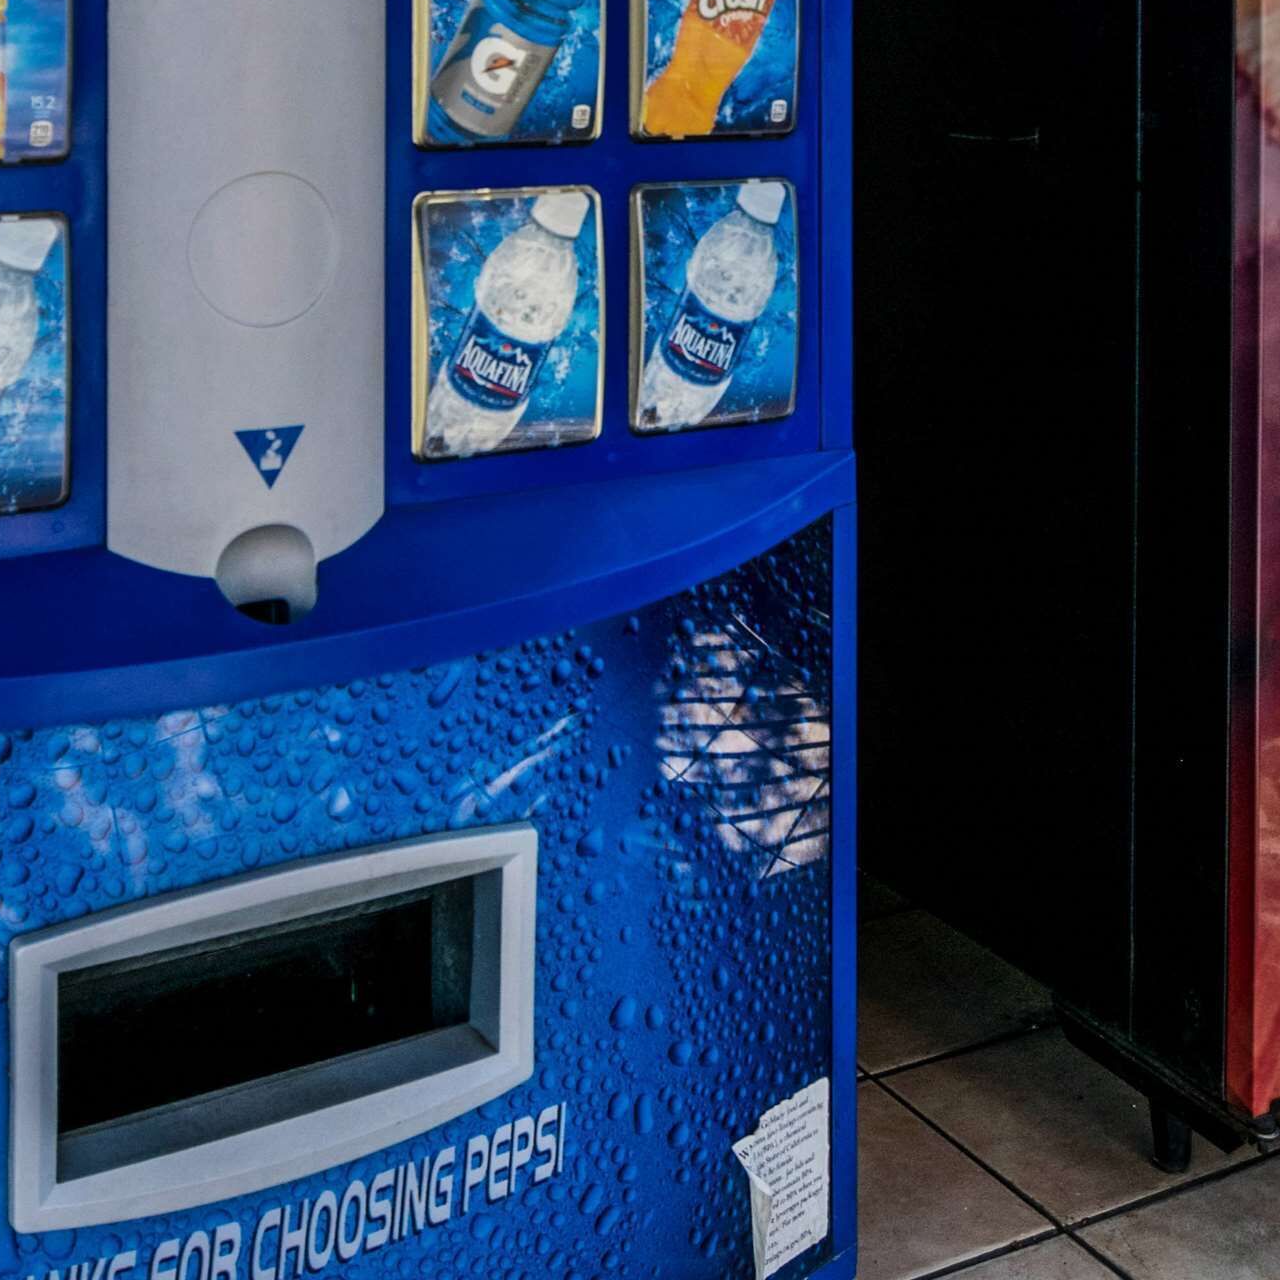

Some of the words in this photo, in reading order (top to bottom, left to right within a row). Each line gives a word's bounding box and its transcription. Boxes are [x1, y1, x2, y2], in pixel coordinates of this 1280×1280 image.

[470, 36, 527, 96] G
[456, 334, 533, 394] AQUAFINA
[668, 312, 737, 370] AQUAFINA
[151, 1221, 242, 1280] FOR
[252, 1146, 457, 1280] CHOOSING
[463, 1101, 568, 1212] PEPSI
